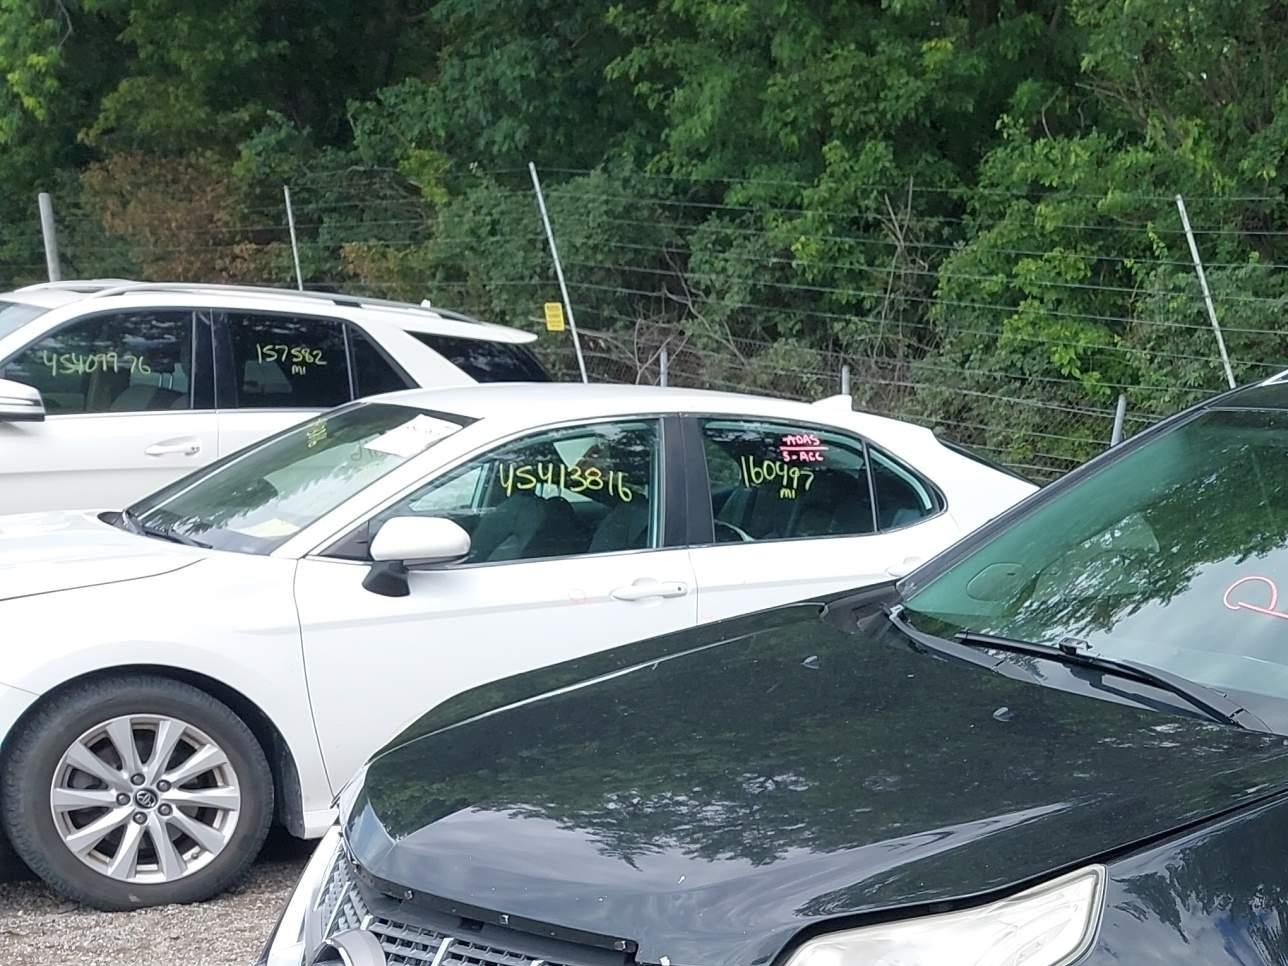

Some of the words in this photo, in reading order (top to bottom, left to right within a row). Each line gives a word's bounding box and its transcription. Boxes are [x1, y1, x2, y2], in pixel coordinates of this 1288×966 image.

[256, 343, 327, 365] 157582
[500, 462, 633, 502] 45413816
[741, 455, 815, 491] 160497
